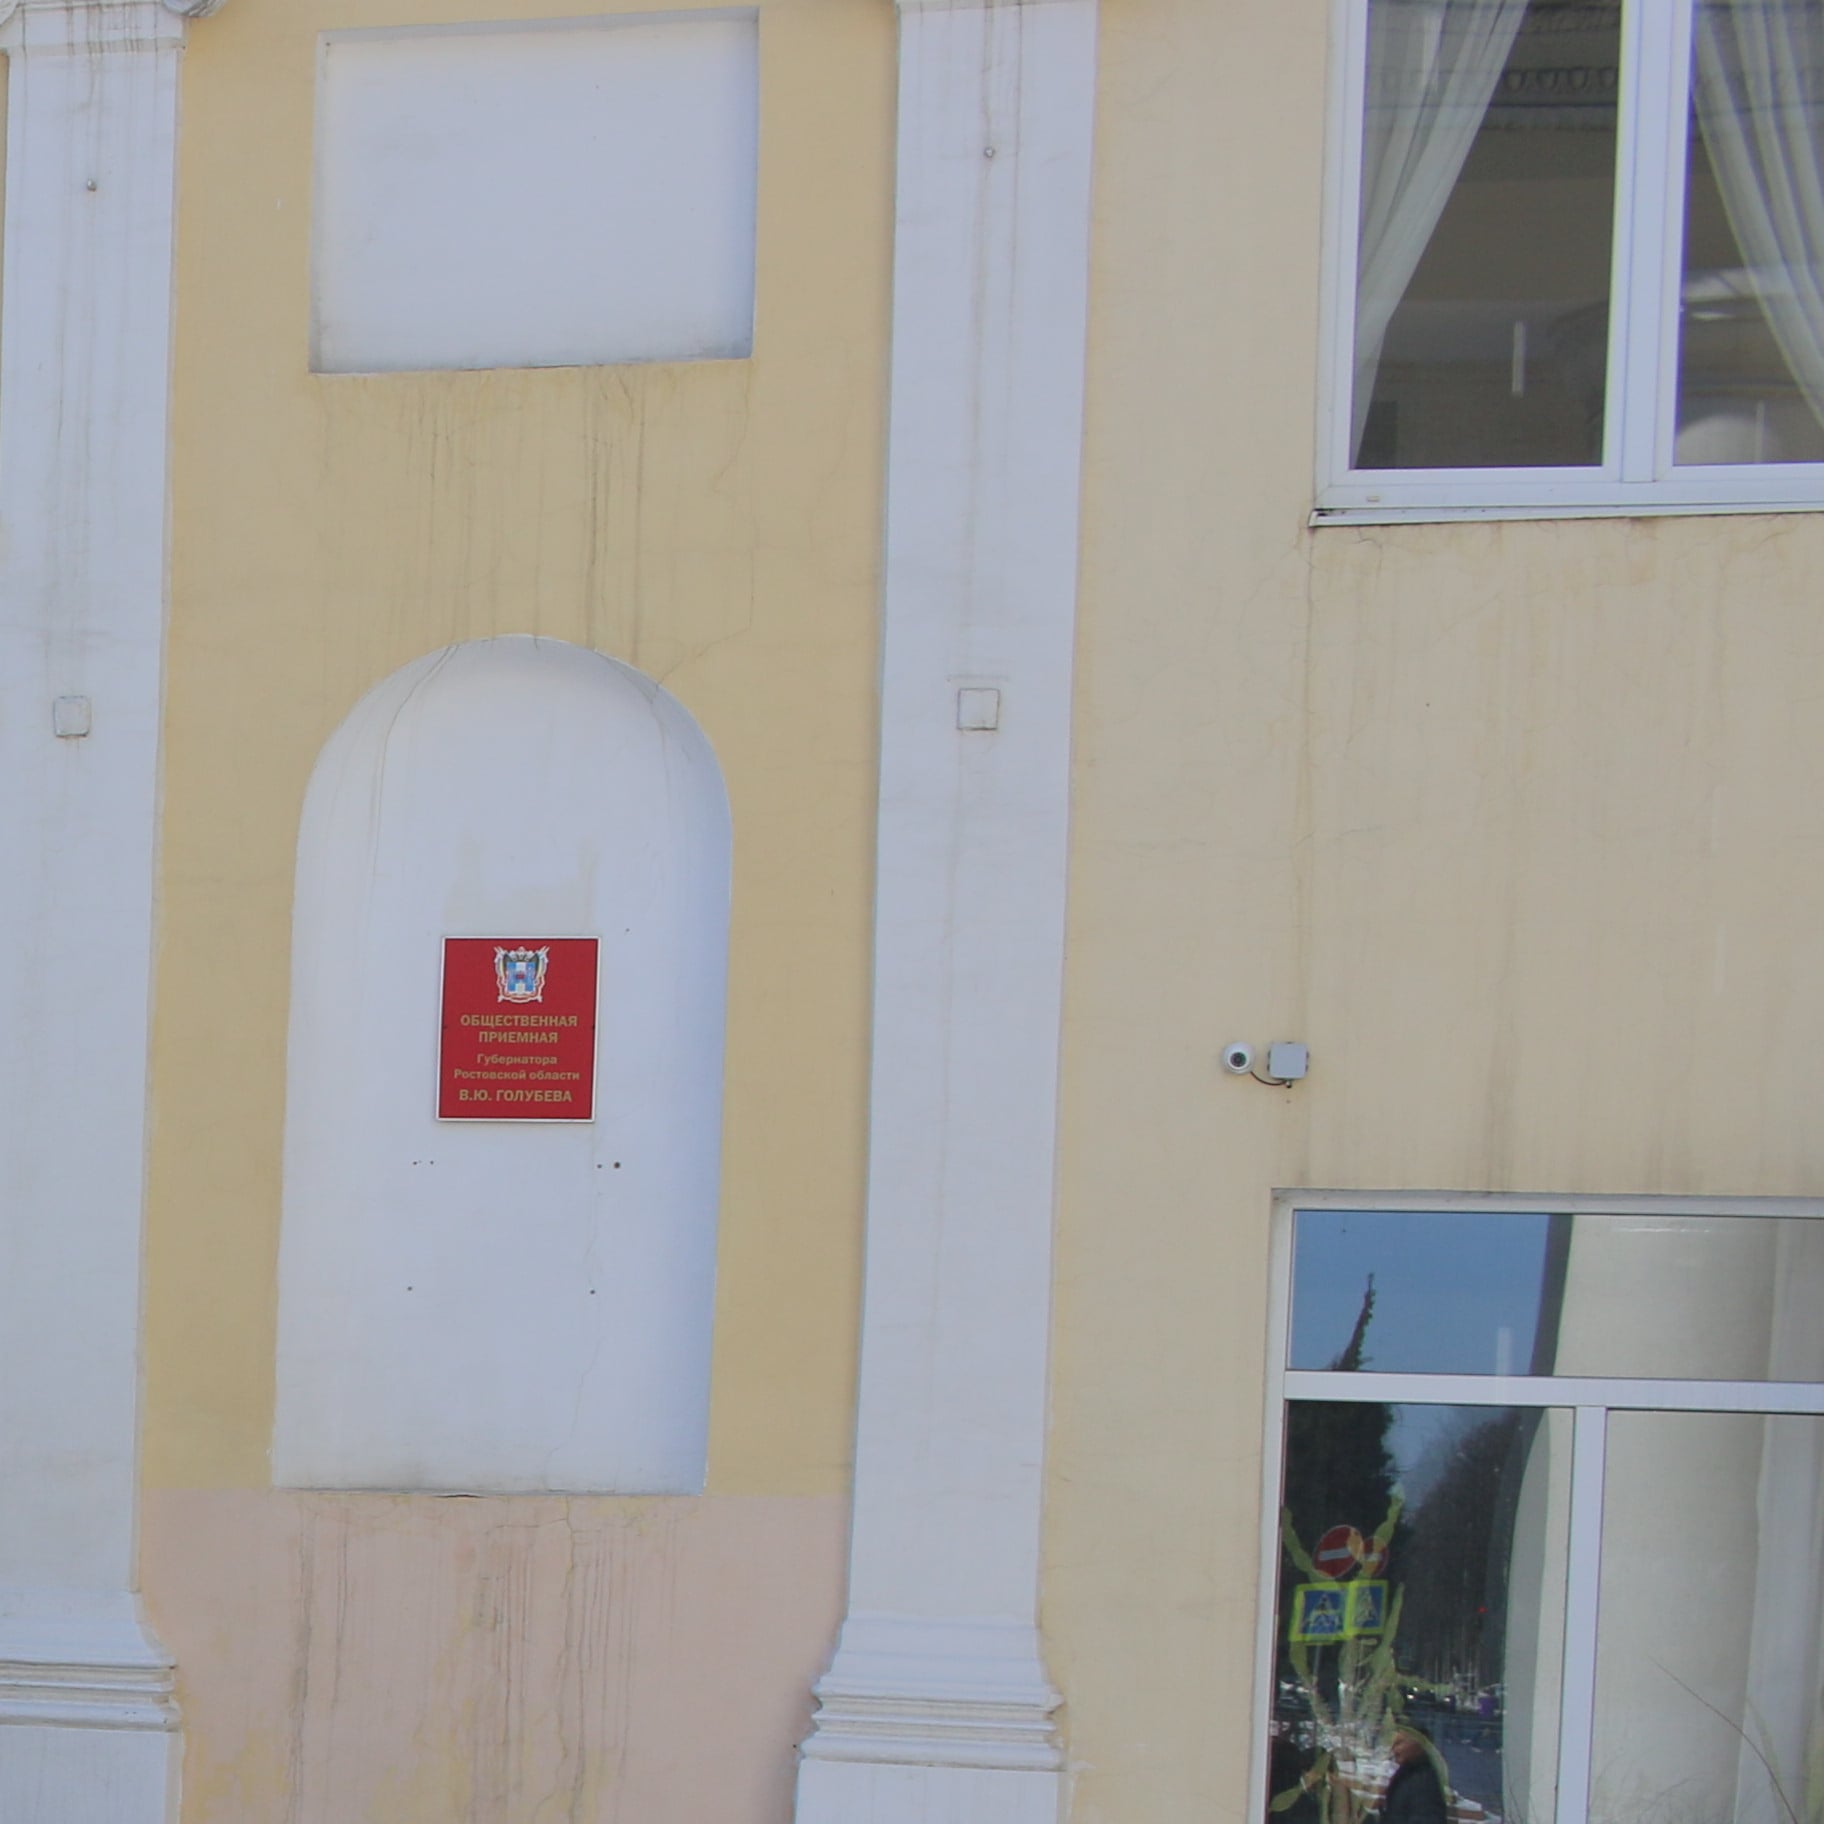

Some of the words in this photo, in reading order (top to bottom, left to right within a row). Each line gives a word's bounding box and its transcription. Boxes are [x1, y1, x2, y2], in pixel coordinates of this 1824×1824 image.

[460, 1014, 578, 1028] ОБЩЕСТВЕННАЯ
[478, 1031, 558, 1043] ПРИЕМНАЯ
[477, 1053, 558, 1066] Губернатора
[454, 1069, 526, 1080] Ростовской
[529, 1070, 580, 1081] области
[496, 1090, 573, 1103] ГОЛУБЕВА
